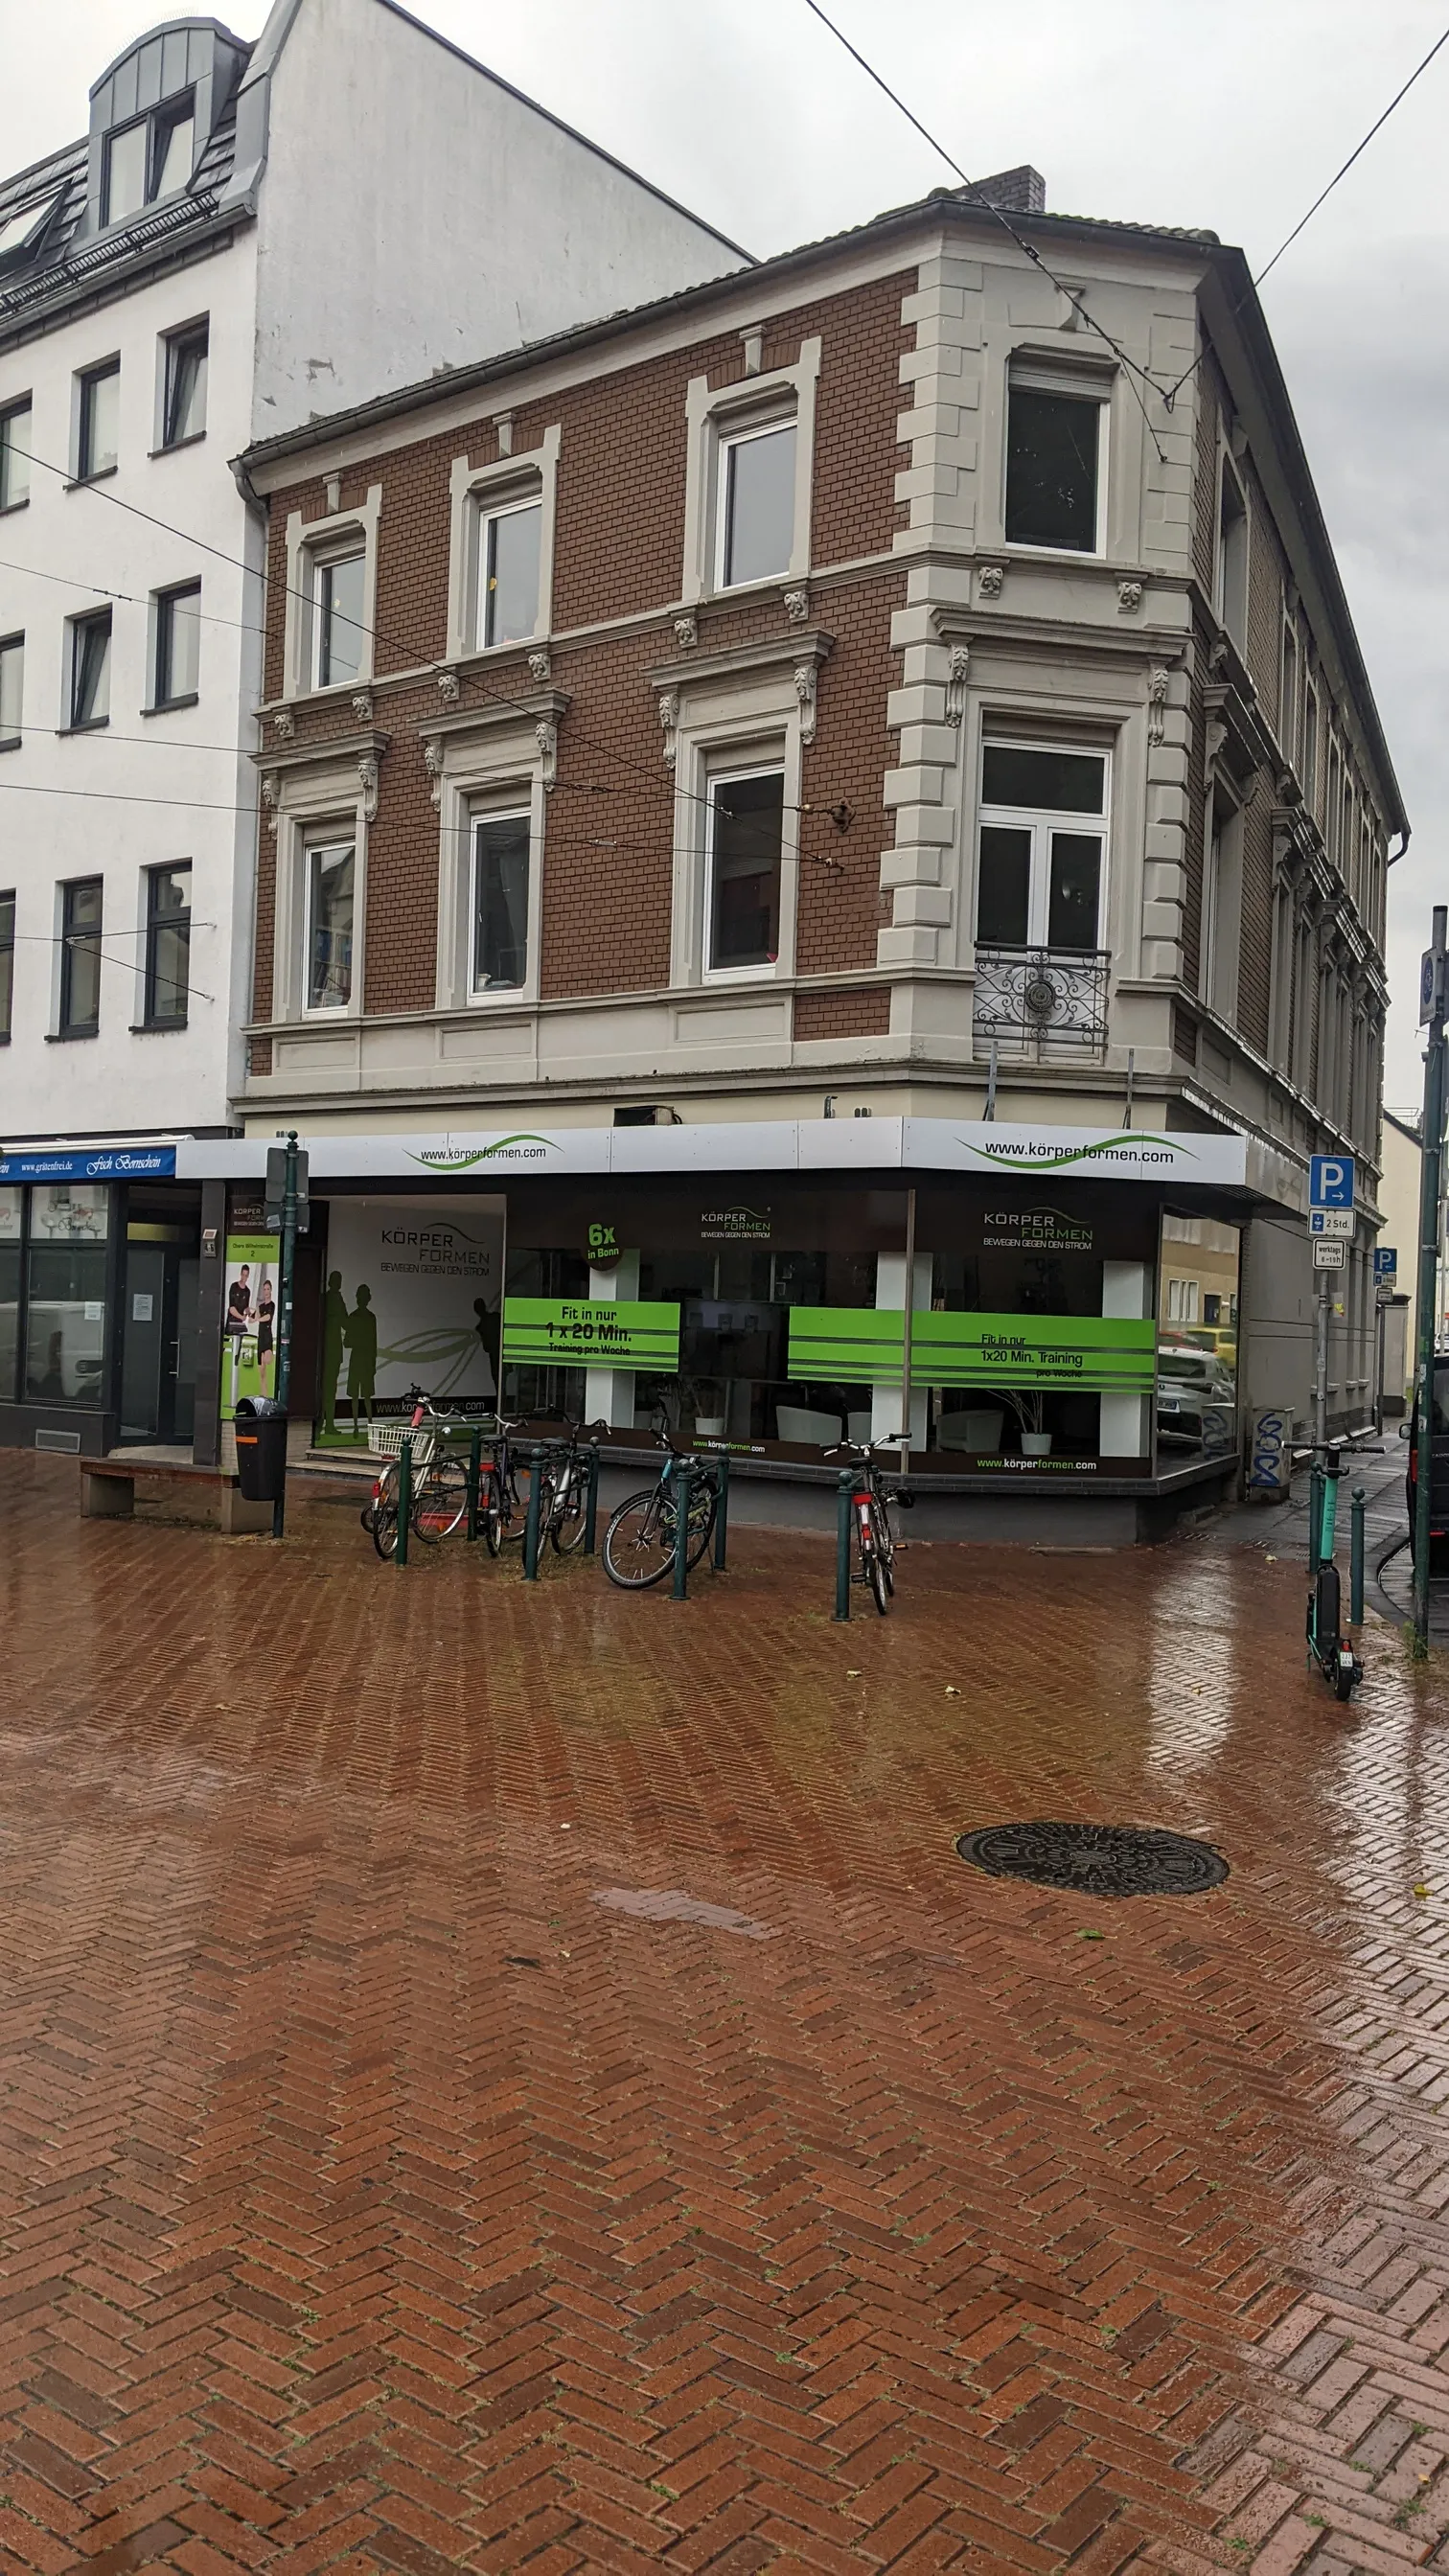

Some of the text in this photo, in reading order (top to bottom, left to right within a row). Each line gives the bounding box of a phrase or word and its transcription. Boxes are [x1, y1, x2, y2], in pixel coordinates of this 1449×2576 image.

[421, 1146, 546, 1162] www.körperformen.com
[985, 1141, 1174, 1163] www.körperformen.com
[21, 1161, 73, 1174] www.grätenfrei.de
[115, 1154, 162, 1170] Bornschein
[1320, 1162, 1345, 1200] P
[702, 1211, 747, 1222] KÖRPER
[983, 1211, 1054, 1227] KÖRPER
[1325, 1219, 1349, 1229] 2 Std.
[381, 1227, 453, 1247] KÖRPER
[588, 1223, 615, 1247] 6x
[1022, 1228, 1092, 1240] FORMEN
[983, 1237, 1092, 1250] BEWEGEN GEGEN DEN STROM
[419, 1248, 490, 1264] FORMEN
[587, 1248, 619, 1259] in Bonn
[1379, 1252, 1392, 1270] P
[380, 1262, 490, 1276] BEWEGEN GEGEN DEN STROM
[562, 1306, 617, 1321] Fit in nur
[545, 1322, 632, 1342] 1 x 20 Min.
[981, 1333, 996, 1344] Fit
[999, 1334, 1007, 1345] in
[548, 1342, 631, 1356] Training pro Woche
[981, 1349, 1083, 1368] 1x20 Min. Training
[1036, 1368, 1083, 1378] pro Woche
[977, 1458, 1097, 1470] www.körperformen.com
